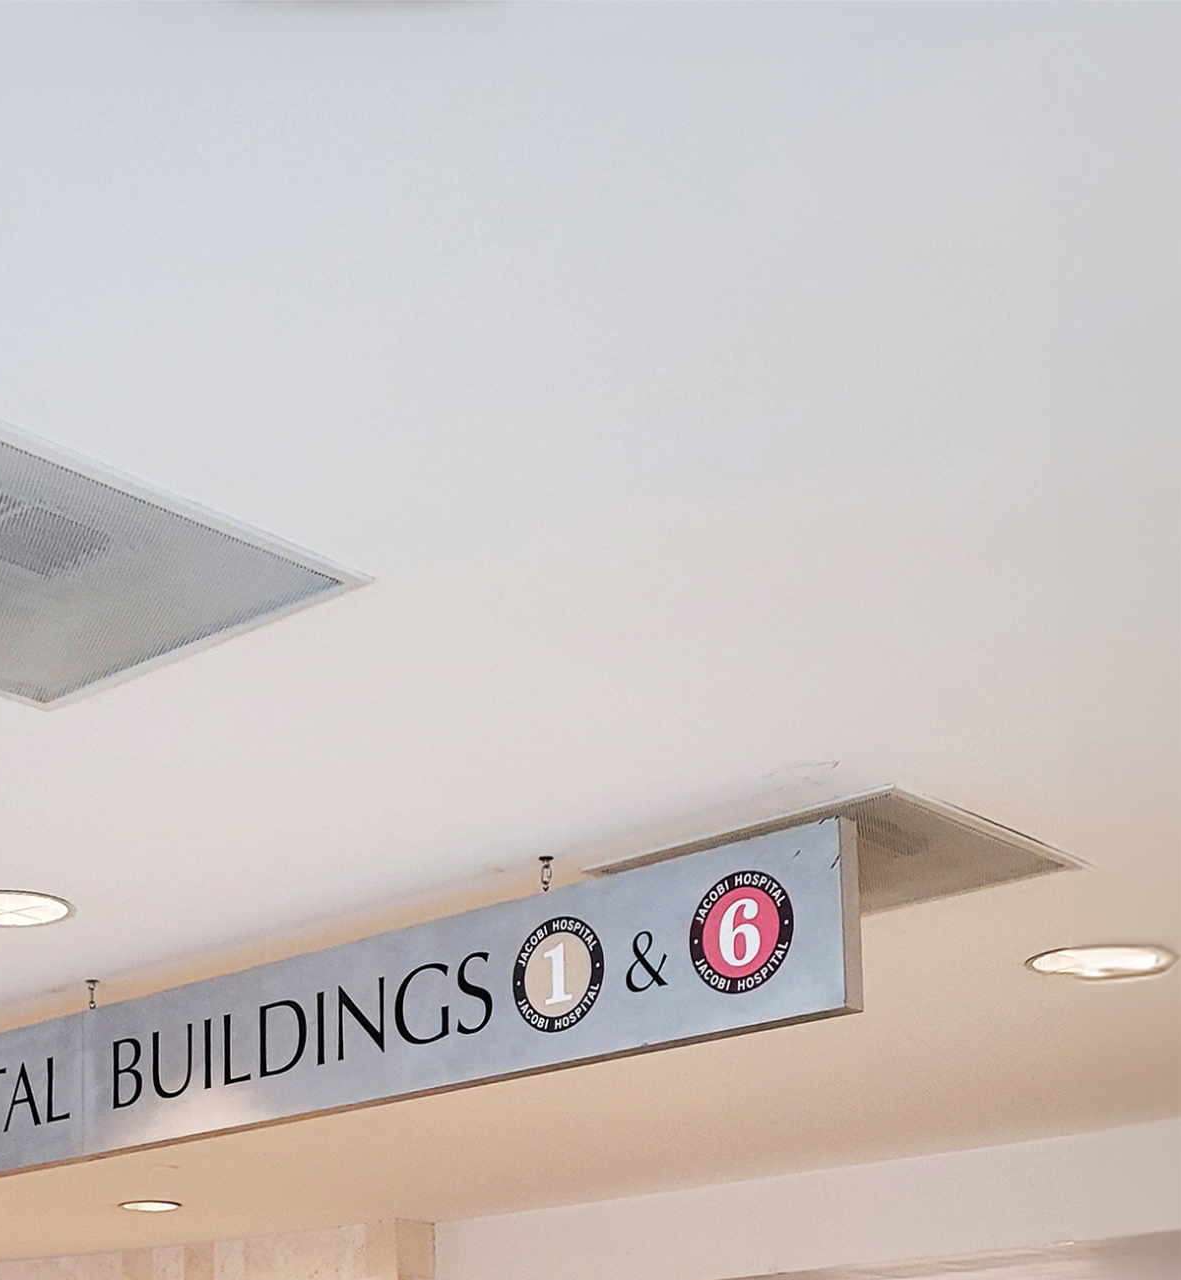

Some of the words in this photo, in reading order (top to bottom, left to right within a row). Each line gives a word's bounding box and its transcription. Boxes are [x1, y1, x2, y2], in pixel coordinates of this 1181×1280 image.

[696, 879, 730, 926] JACOBI
[733, 872, 786, 908] HOSPITAL
[517, 927, 549, 967] JACOBI
[551, 918, 598, 952] HOSPITAL
[695, 957, 730, 992] JACOBI
[736, 937, 789, 992] HOSPITAL
[112, 951, 494, 1110] BUILDINGS
[542, 941, 574, 1007] 1
[625, 930, 669, 994] &
[718, 897, 761, 967] 6
[517, 997, 549, 1030] JACOBI
[554, 981, 600, 1030] HOSPITAL
